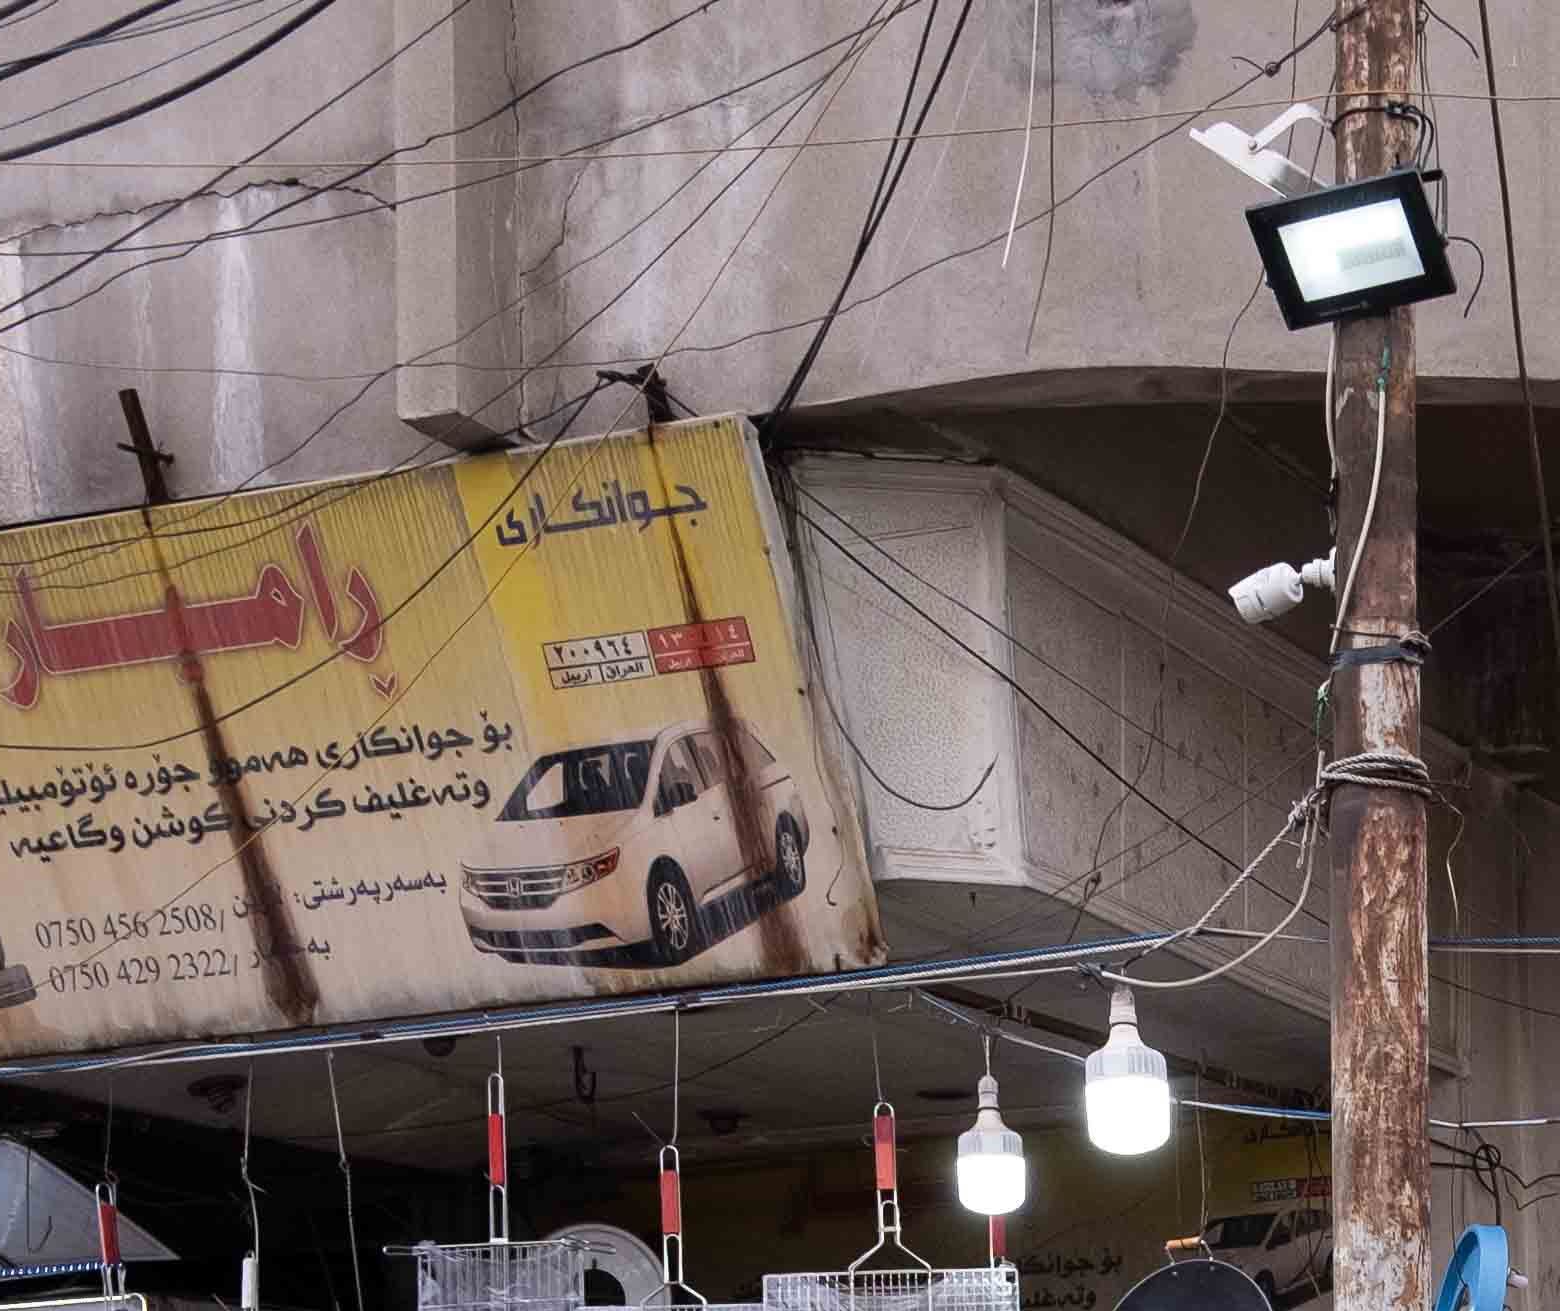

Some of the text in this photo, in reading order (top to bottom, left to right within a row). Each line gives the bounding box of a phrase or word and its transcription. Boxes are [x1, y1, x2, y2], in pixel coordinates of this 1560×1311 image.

[35, 912, 96, 950] 0750
[102, 909, 147, 943] 456
[48, 958, 109, 995] 0750
[117, 955, 160, 988] 429
